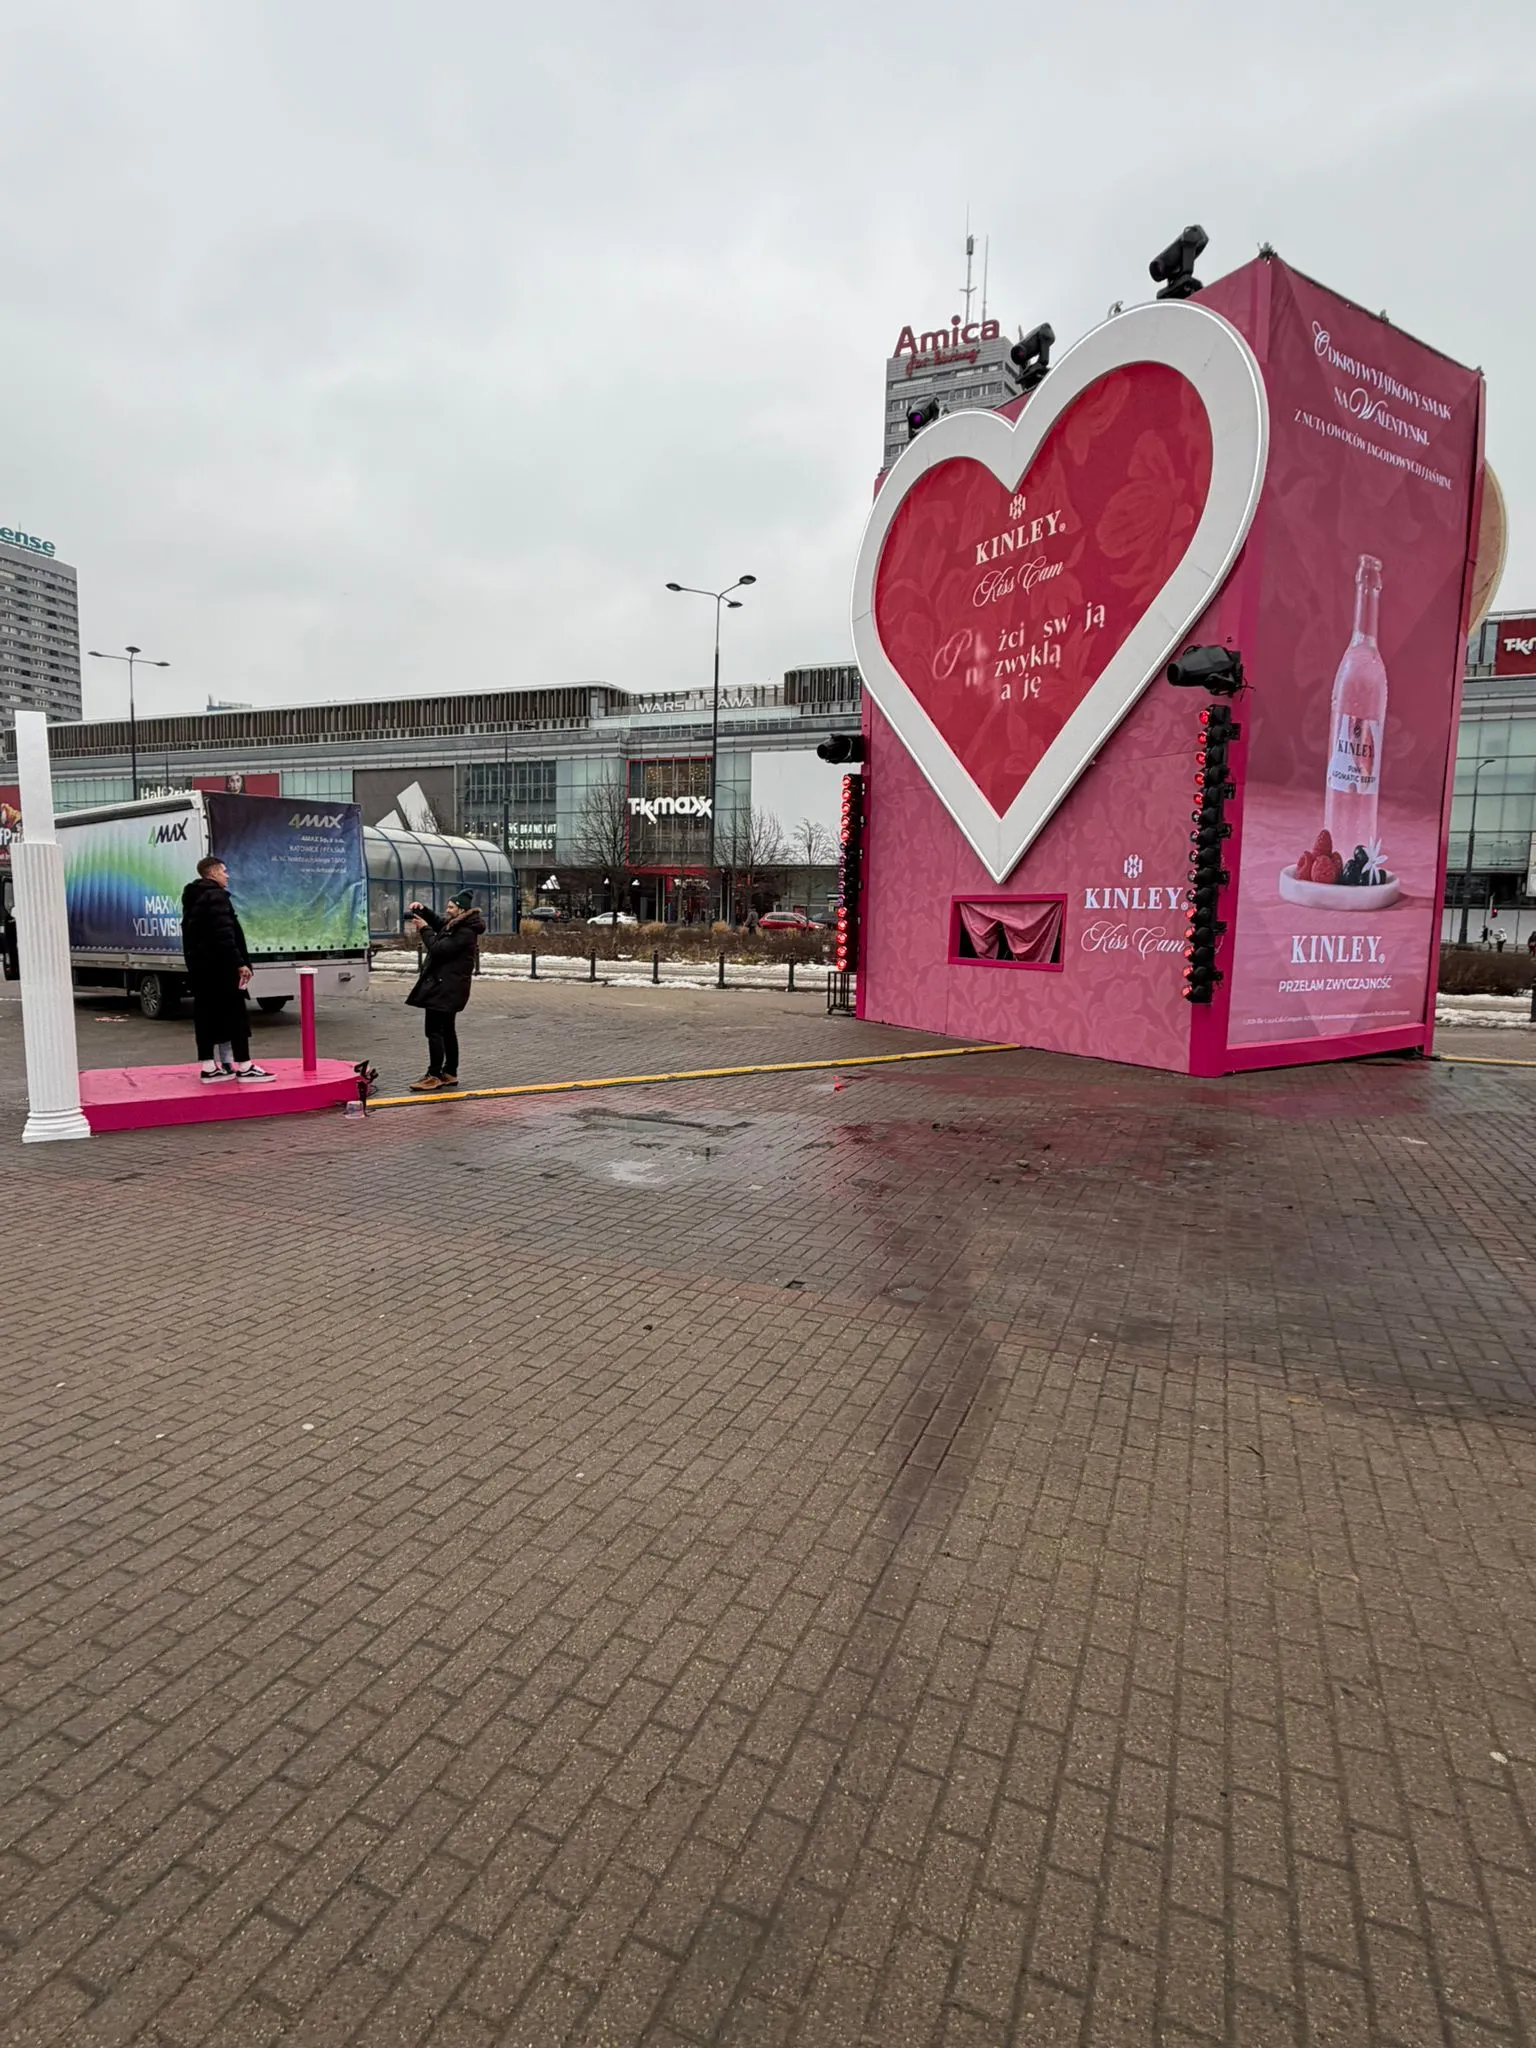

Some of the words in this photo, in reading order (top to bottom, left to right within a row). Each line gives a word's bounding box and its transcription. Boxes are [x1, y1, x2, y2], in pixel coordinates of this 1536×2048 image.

[893, 314, 1000, 359] Amica
[1421, 395, 1452, 420] SMAK
[0, 527, 56, 554] ense
[972, 565, 1016, 608] Kiss
[1017, 555, 1064, 595] Cam
[638, 700, 685, 714] WARS
[706, 696, 754, 709] SAWA
[148, 817, 189, 848] 4MAX
[288, 813, 344, 829] 4MAX
[1080, 920, 1129, 953] Kiss
[1132, 926, 1186, 960] Cam
[1278, 979, 1324, 993] PRZEŁAM
[1325, 975, 1392, 991] ZWYCZAJNOŚĆ
